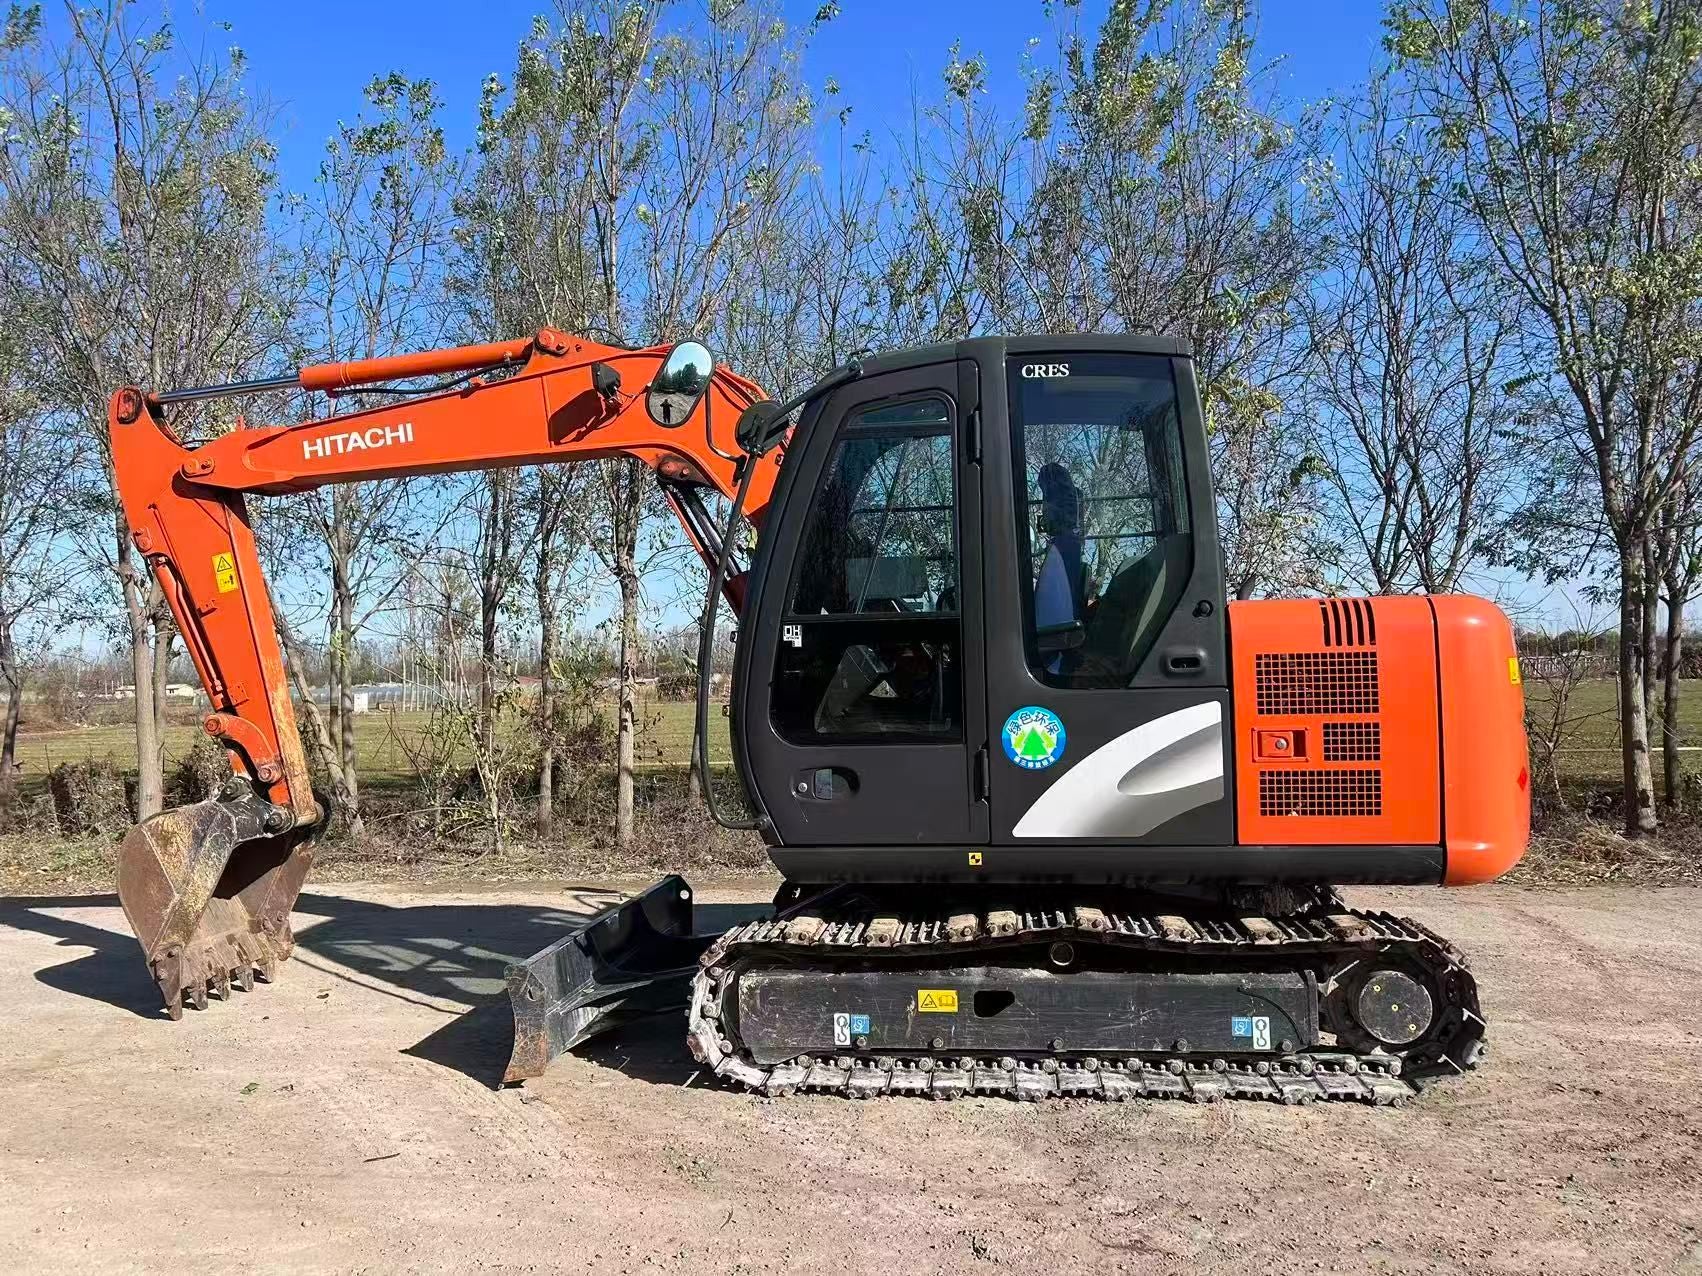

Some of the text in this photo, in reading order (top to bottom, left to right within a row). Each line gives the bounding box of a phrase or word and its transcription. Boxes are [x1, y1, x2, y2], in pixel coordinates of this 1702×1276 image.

[1021, 363, 1070, 378] CRES
[302, 423, 414, 460] HITACHI
[1007, 711, 1061, 736] 绿色环保
